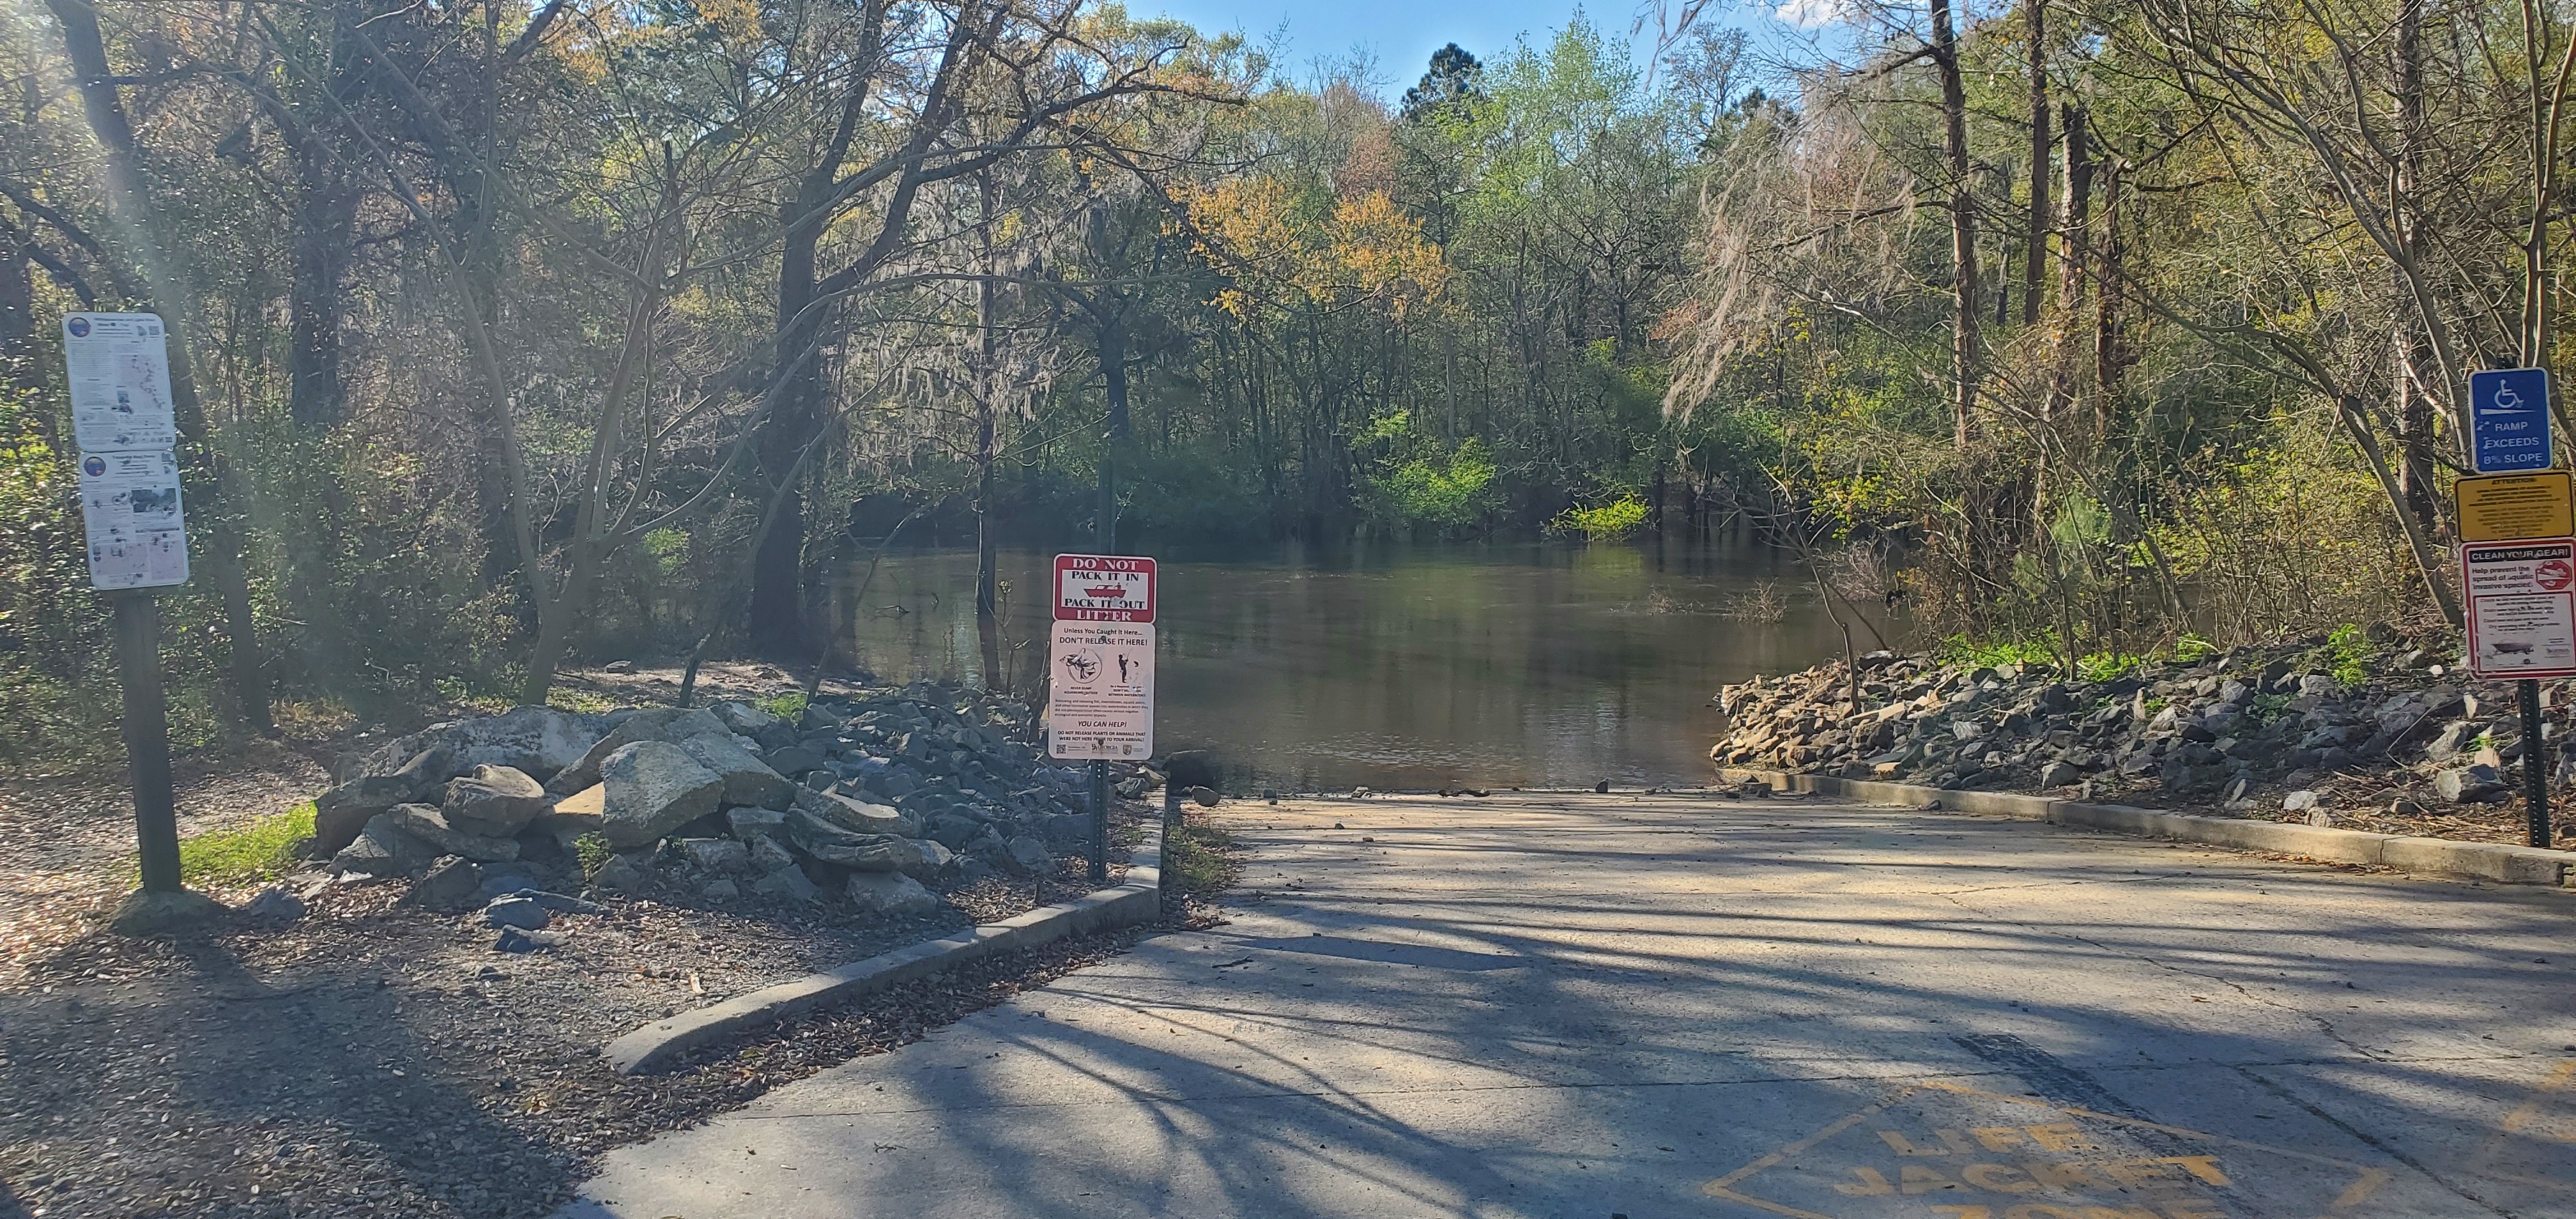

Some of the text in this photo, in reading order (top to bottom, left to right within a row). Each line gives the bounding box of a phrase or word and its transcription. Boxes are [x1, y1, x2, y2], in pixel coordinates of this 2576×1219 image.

[2495, 422, 2528, 431] RAMP
[2485, 437, 2540, 447] EXCEEDS
[2484, 453, 2543, 464] 8% SLOPE
[2472, 551, 2504, 560] CLEAN
[2537, 549, 2568, 557] GEAR!
[1073, 558, 1138, 571] DO NOT
[1071, 571, 1139, 581] PACK IT IN
[1064, 599, 1145, 609] PACK IT OUT
[1077, 610, 1132, 621] LITTER
[1085, 637, 1116, 645] RELEASE
[1876, 1123, 2089, 1156] LIFE
[1832, 1155, 2234, 1195] JACKET
